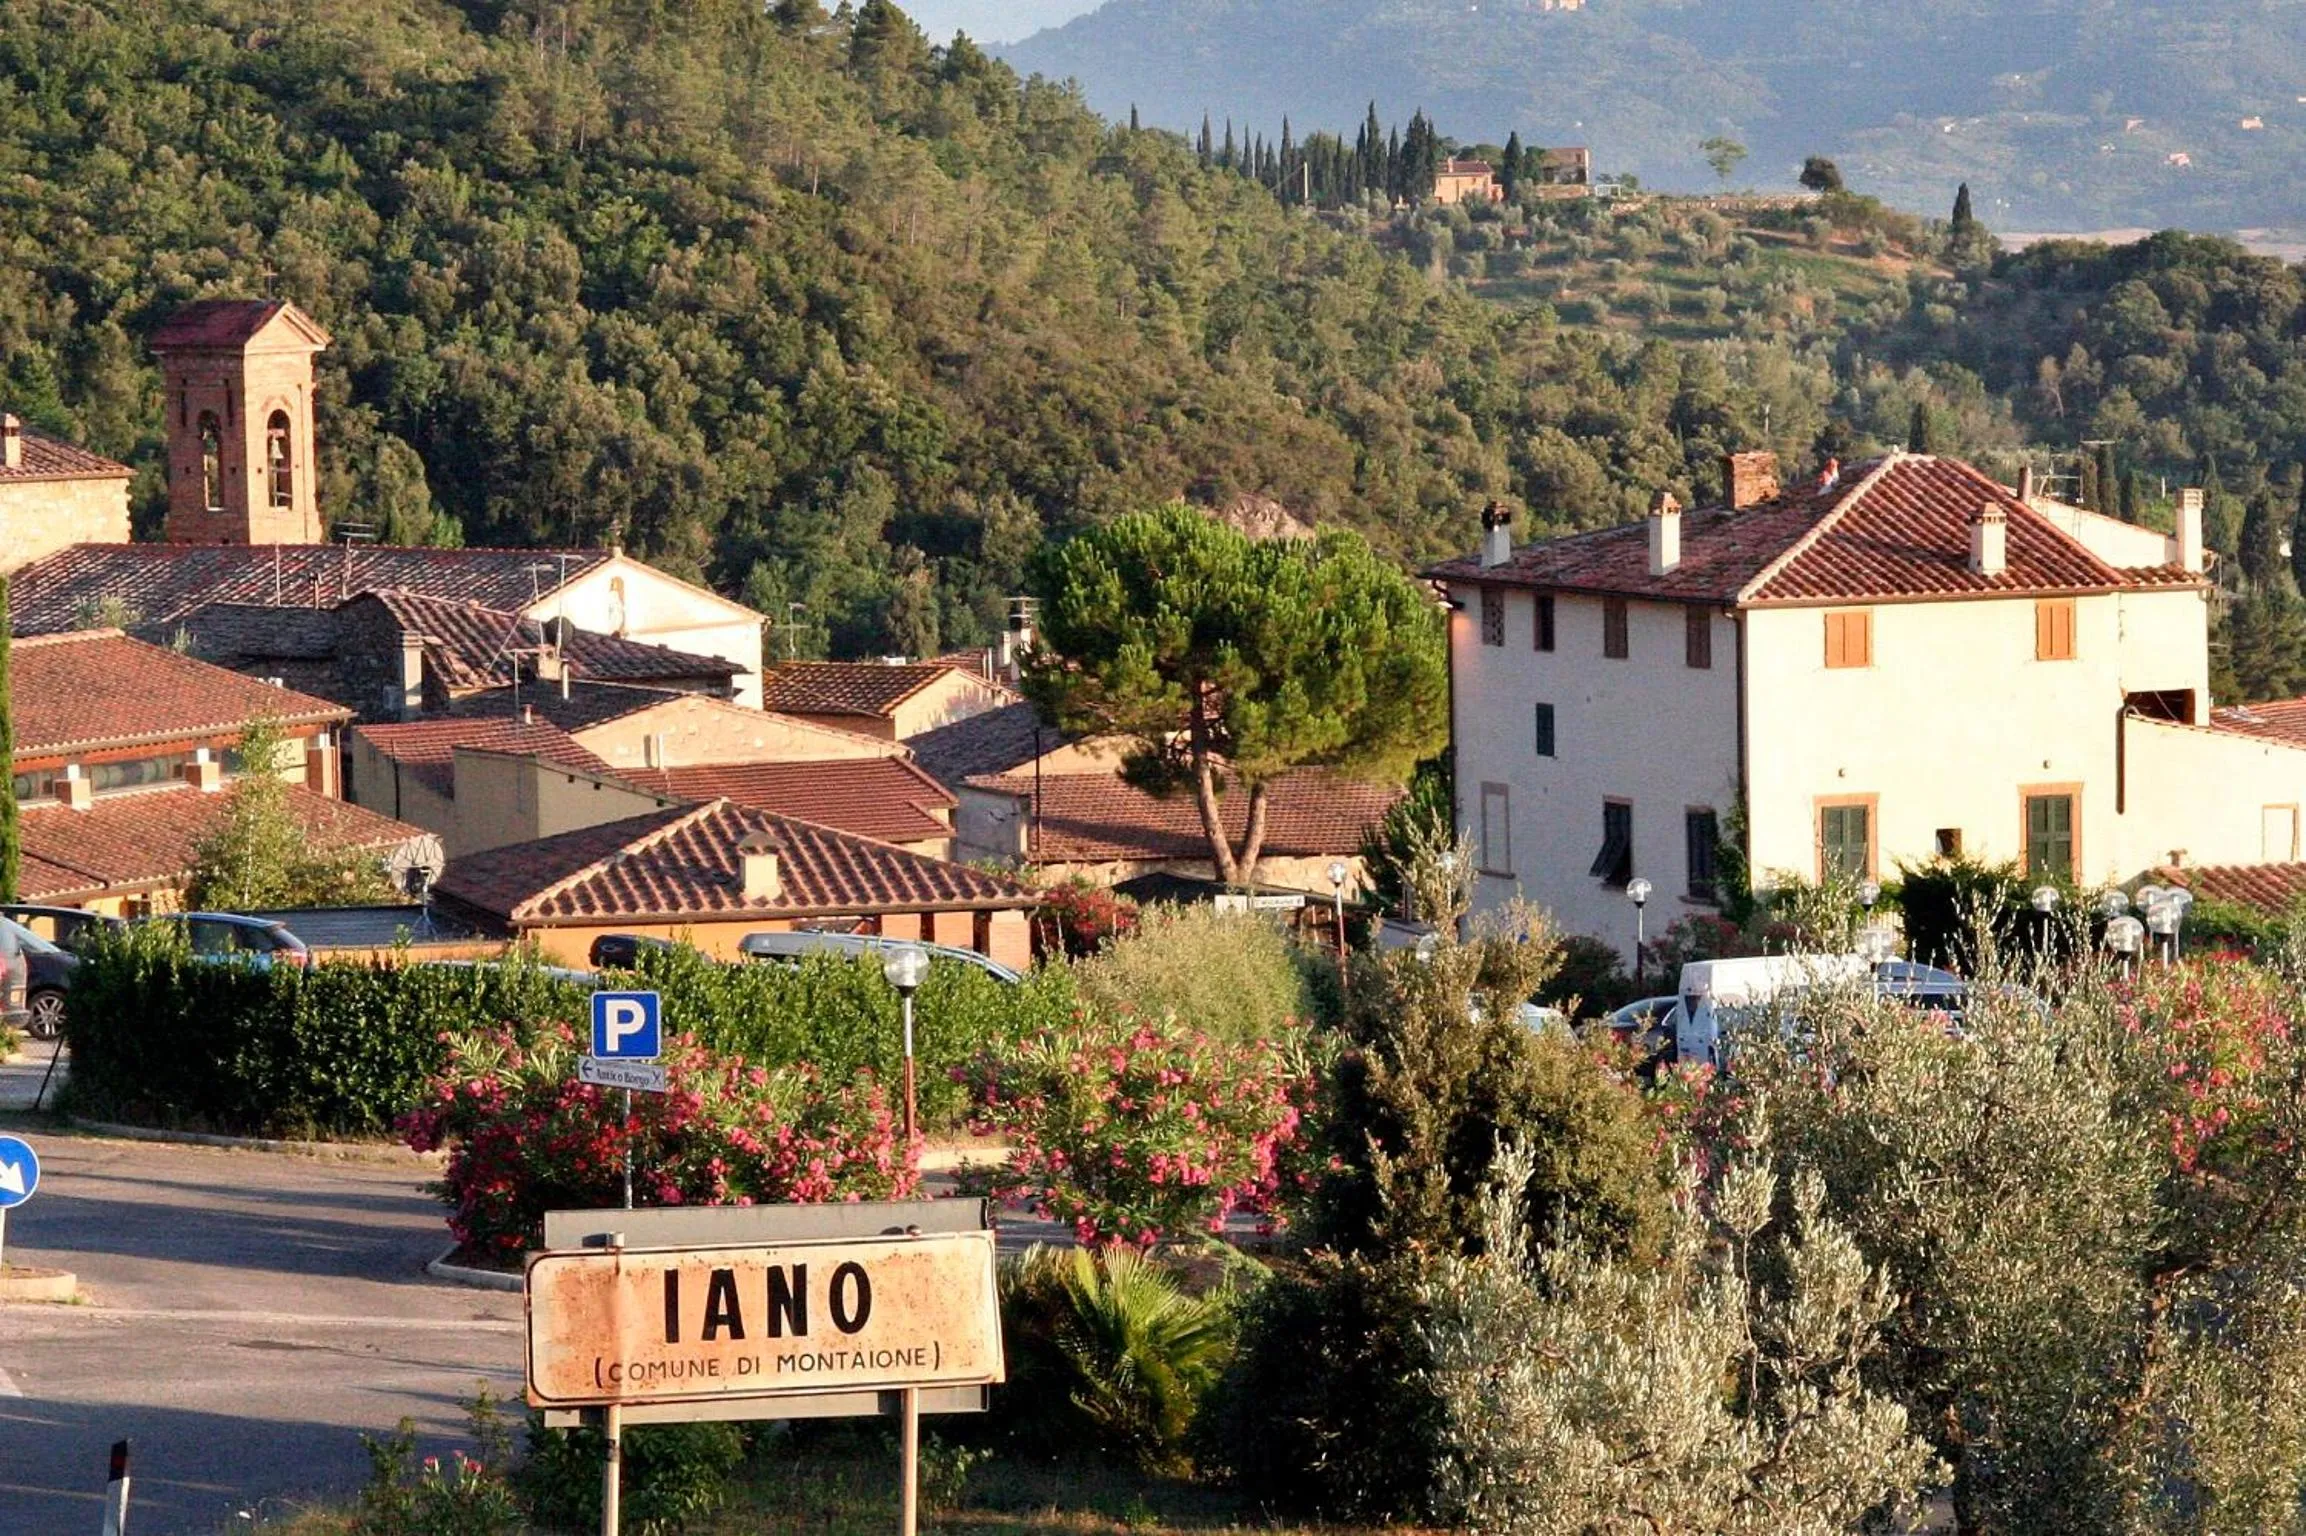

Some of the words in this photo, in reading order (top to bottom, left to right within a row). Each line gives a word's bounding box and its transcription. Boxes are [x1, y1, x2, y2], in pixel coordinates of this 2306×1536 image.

[605, 999, 646, 1053] P
[624, 1071, 650, 1088] Borgo
[664, 1260, 873, 1344] IANO
[594, 1356, 721, 1389] (COMUNE
[737, 1356, 760, 1376] DI
[776, 1340, 941, 1373] MONTAIONE)
